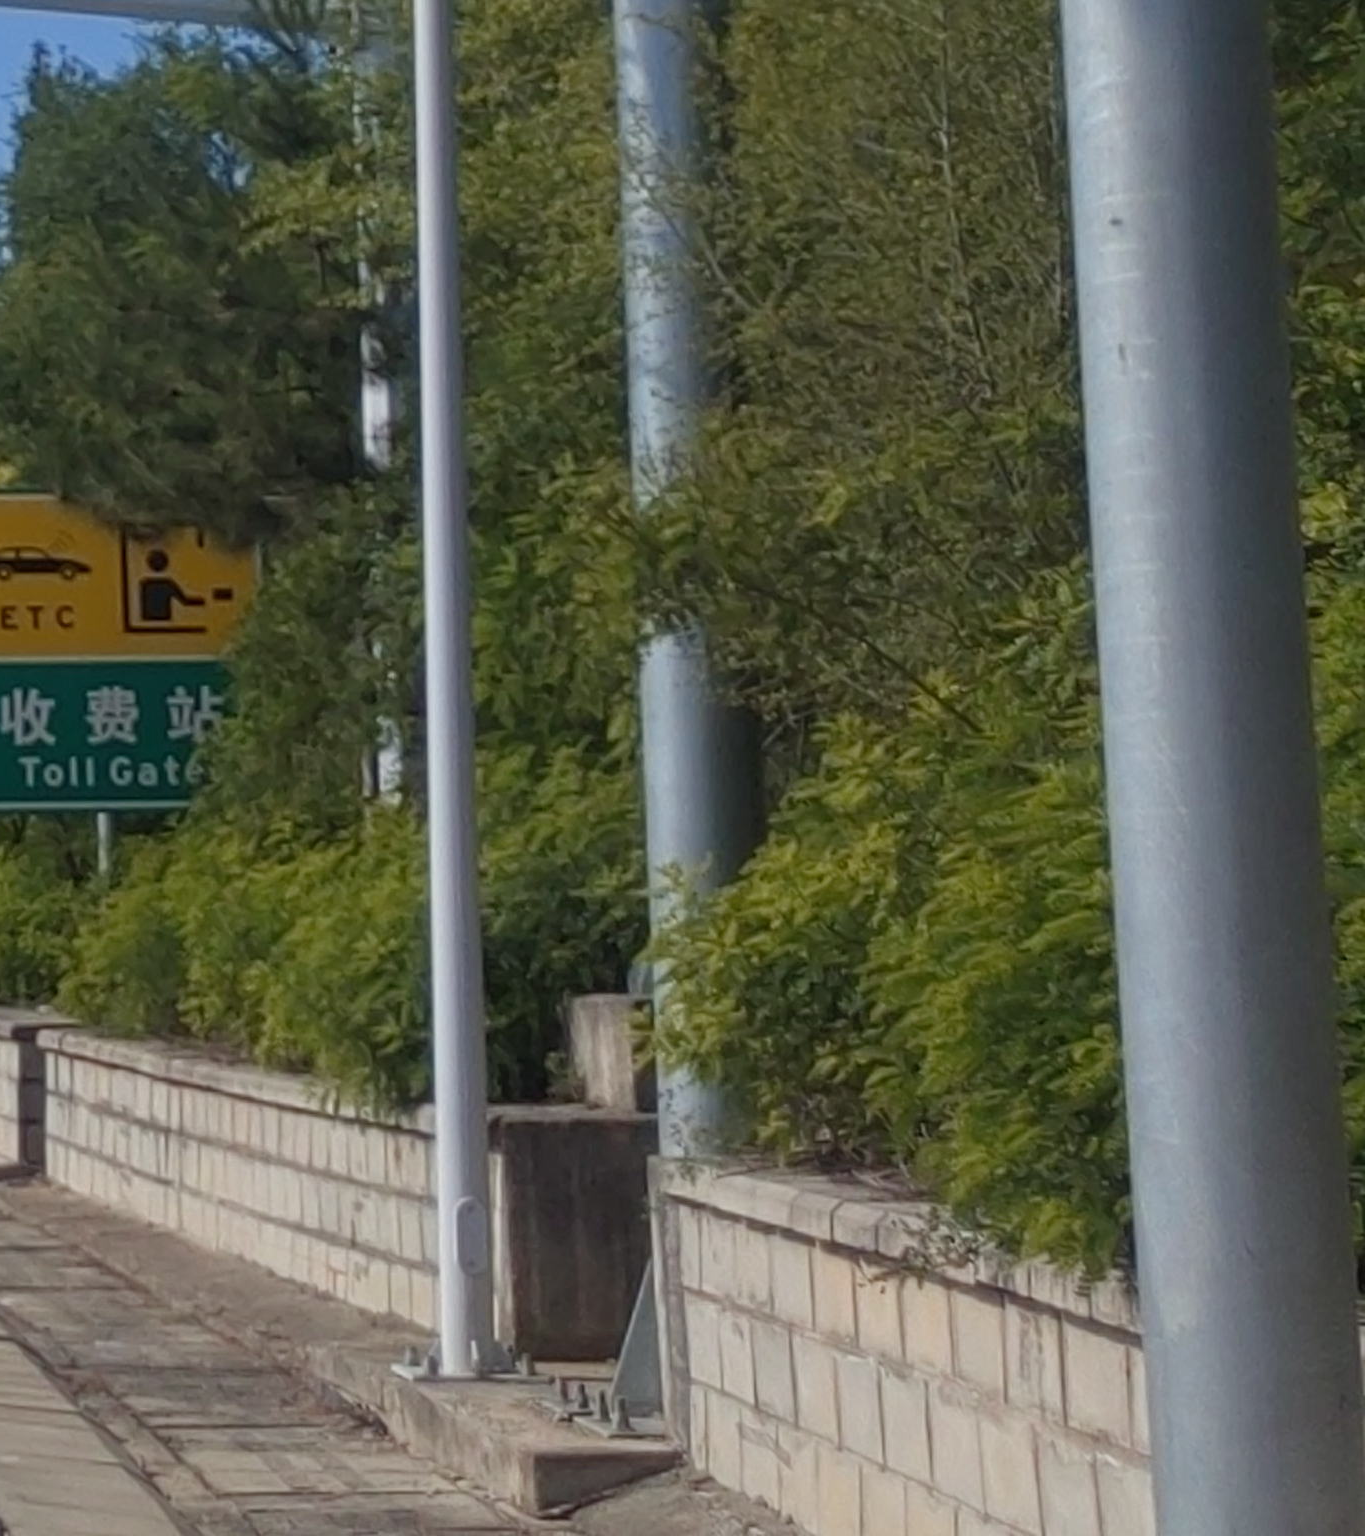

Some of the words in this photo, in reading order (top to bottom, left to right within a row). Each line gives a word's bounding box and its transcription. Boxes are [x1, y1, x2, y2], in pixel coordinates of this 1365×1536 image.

[0, 604, 75, 630] ETC
[0, 684, 225, 747] 收费站
[18, 755, 96, 787] Toll
[108, 755, 206, 787] Gate
